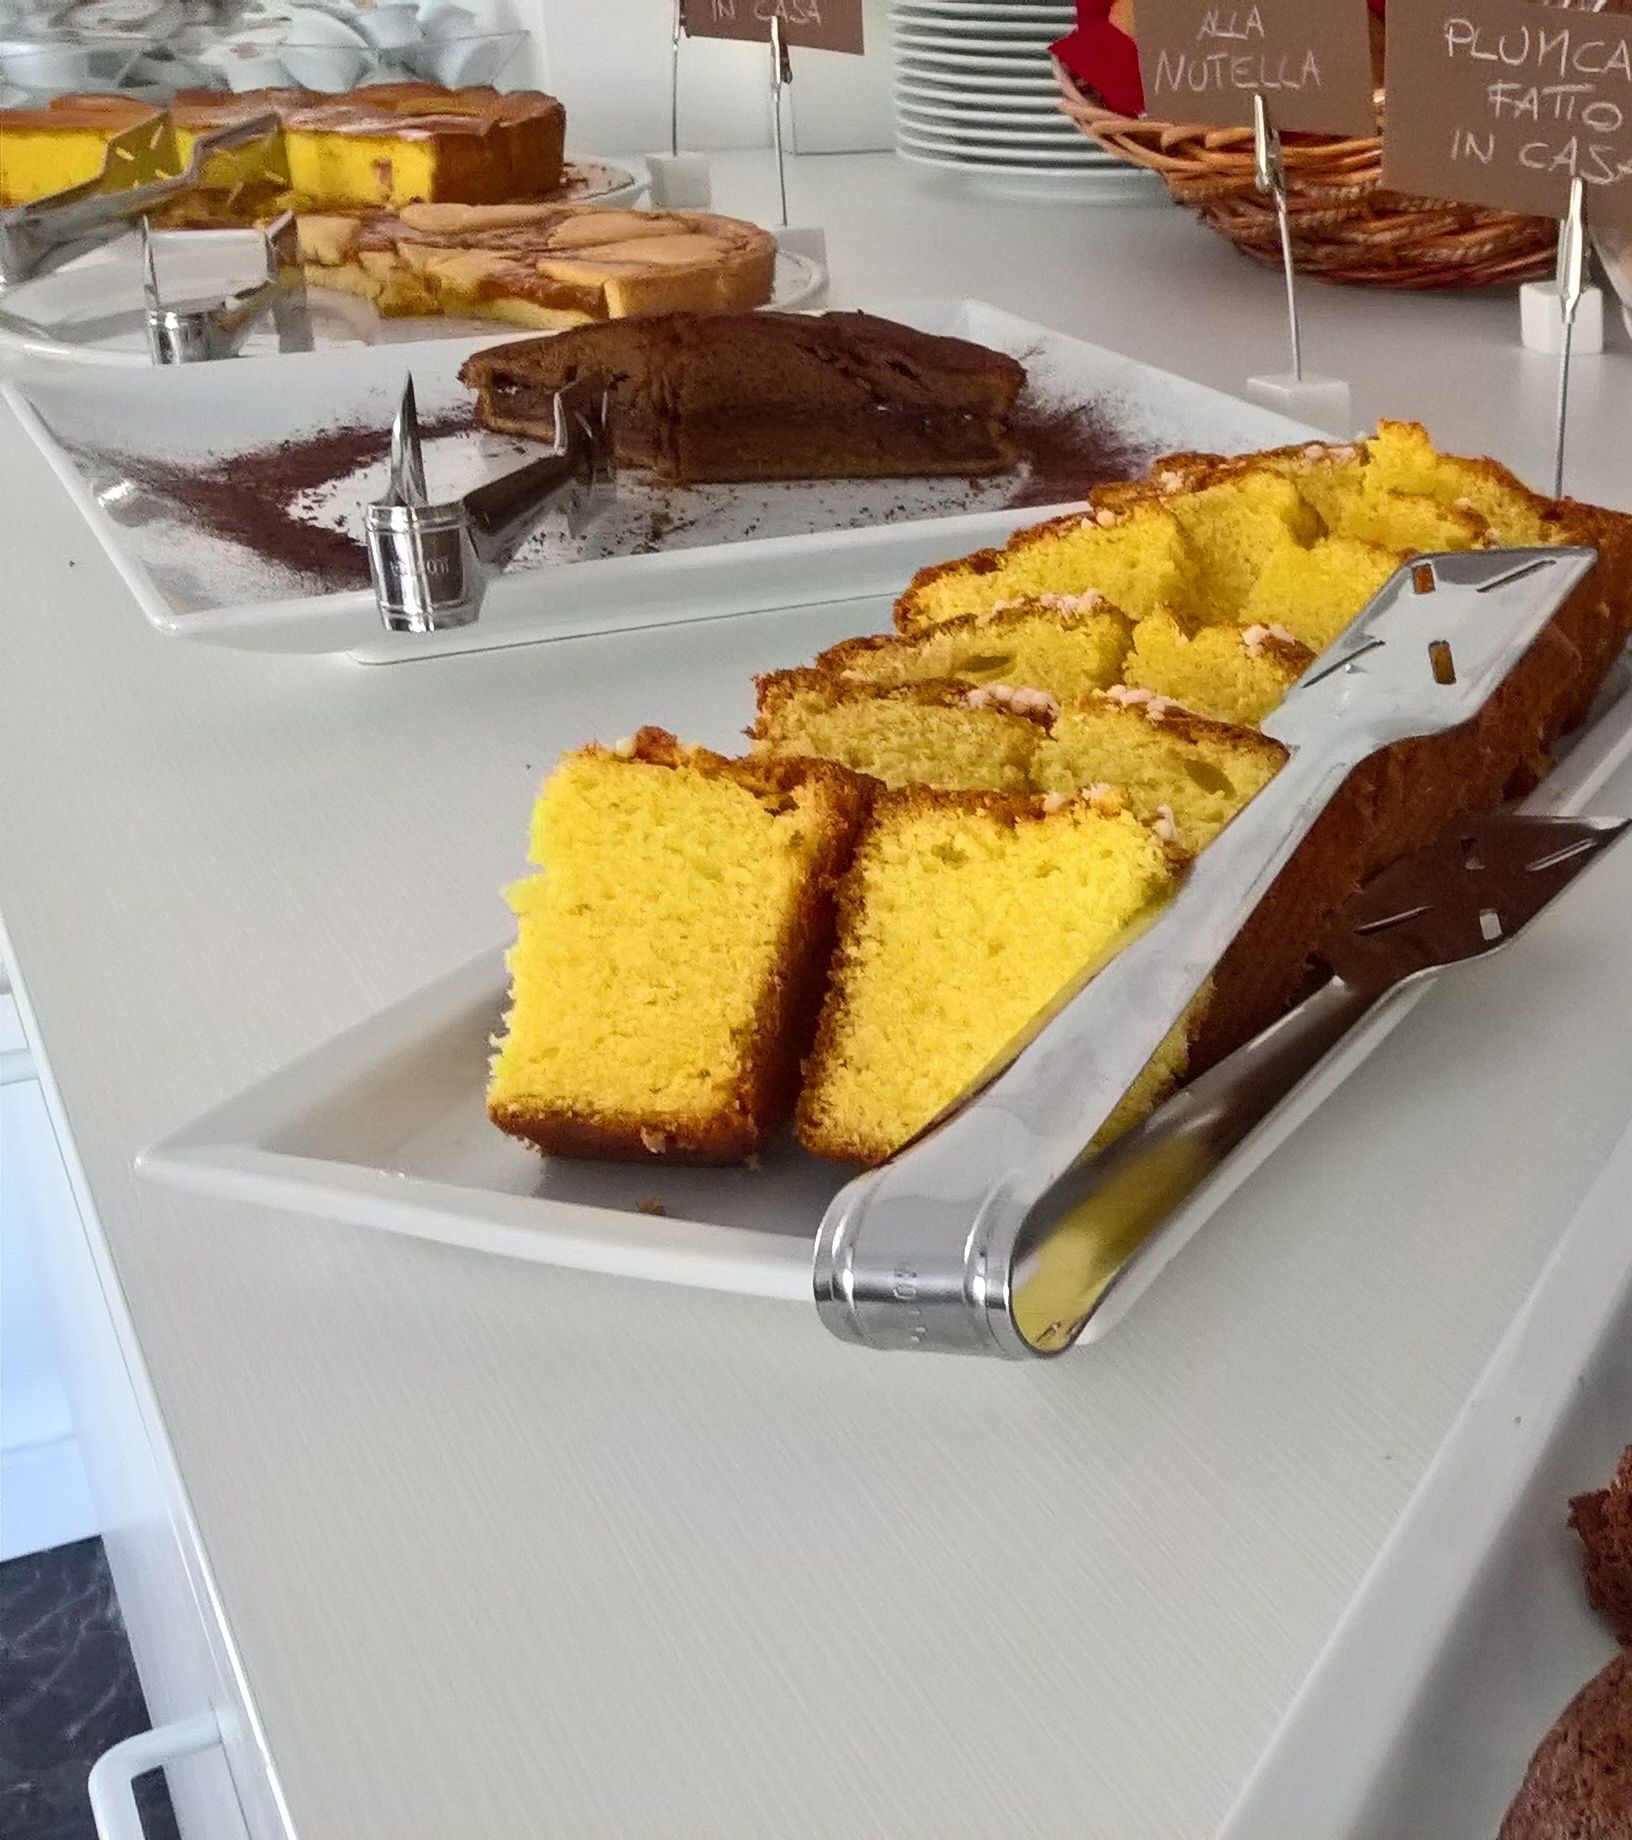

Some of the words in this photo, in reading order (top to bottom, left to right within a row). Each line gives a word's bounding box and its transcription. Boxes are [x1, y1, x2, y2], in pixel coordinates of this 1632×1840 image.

[1197, 4, 1265, 40] ALLA
[1154, 49, 1322, 94] NUTELLA
[1487, 79, 1624, 133] FATTO
[1450, 129, 1496, 165] IN
